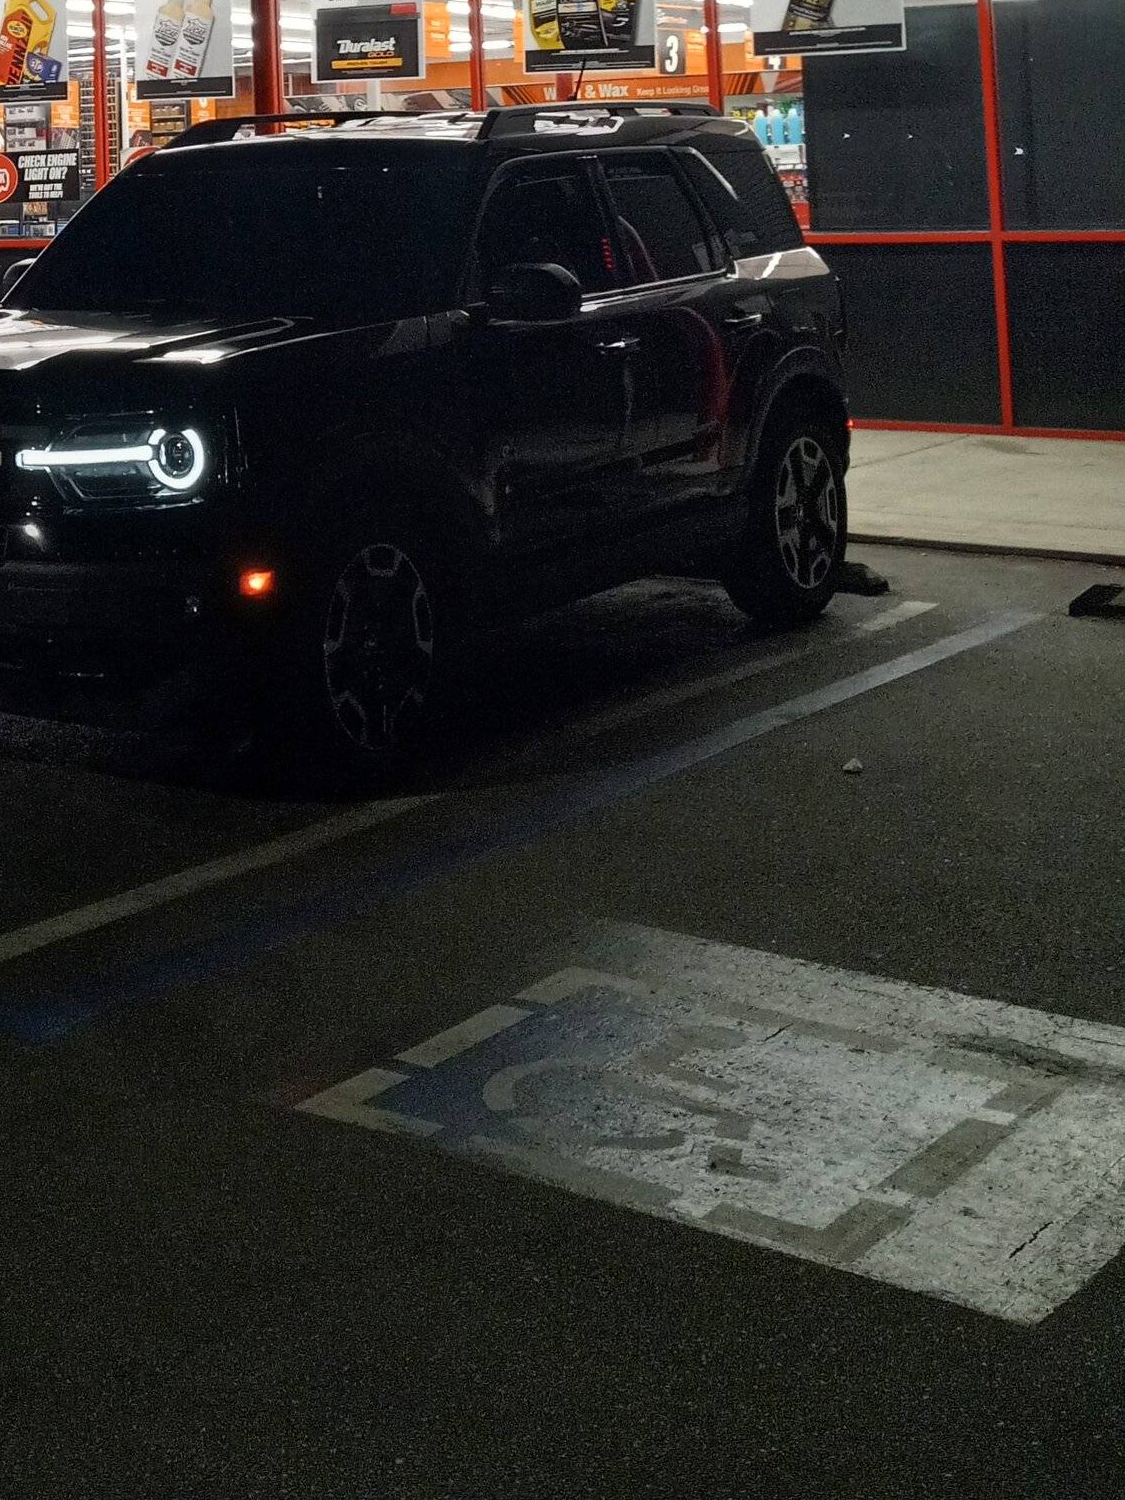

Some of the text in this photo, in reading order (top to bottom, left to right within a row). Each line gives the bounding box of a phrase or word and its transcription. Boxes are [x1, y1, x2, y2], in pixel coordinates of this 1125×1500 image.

[337, 37, 396, 53] Duralast
[665, 35, 679, 72] 3
[585, 84, 596, 98] &
[597, 83, 628, 98] Wax
[636, 87, 655, 97] Keep
[18, 153, 77, 169] CHECK ENGINE
[24, 167, 68, 181] LIGHT ON?
